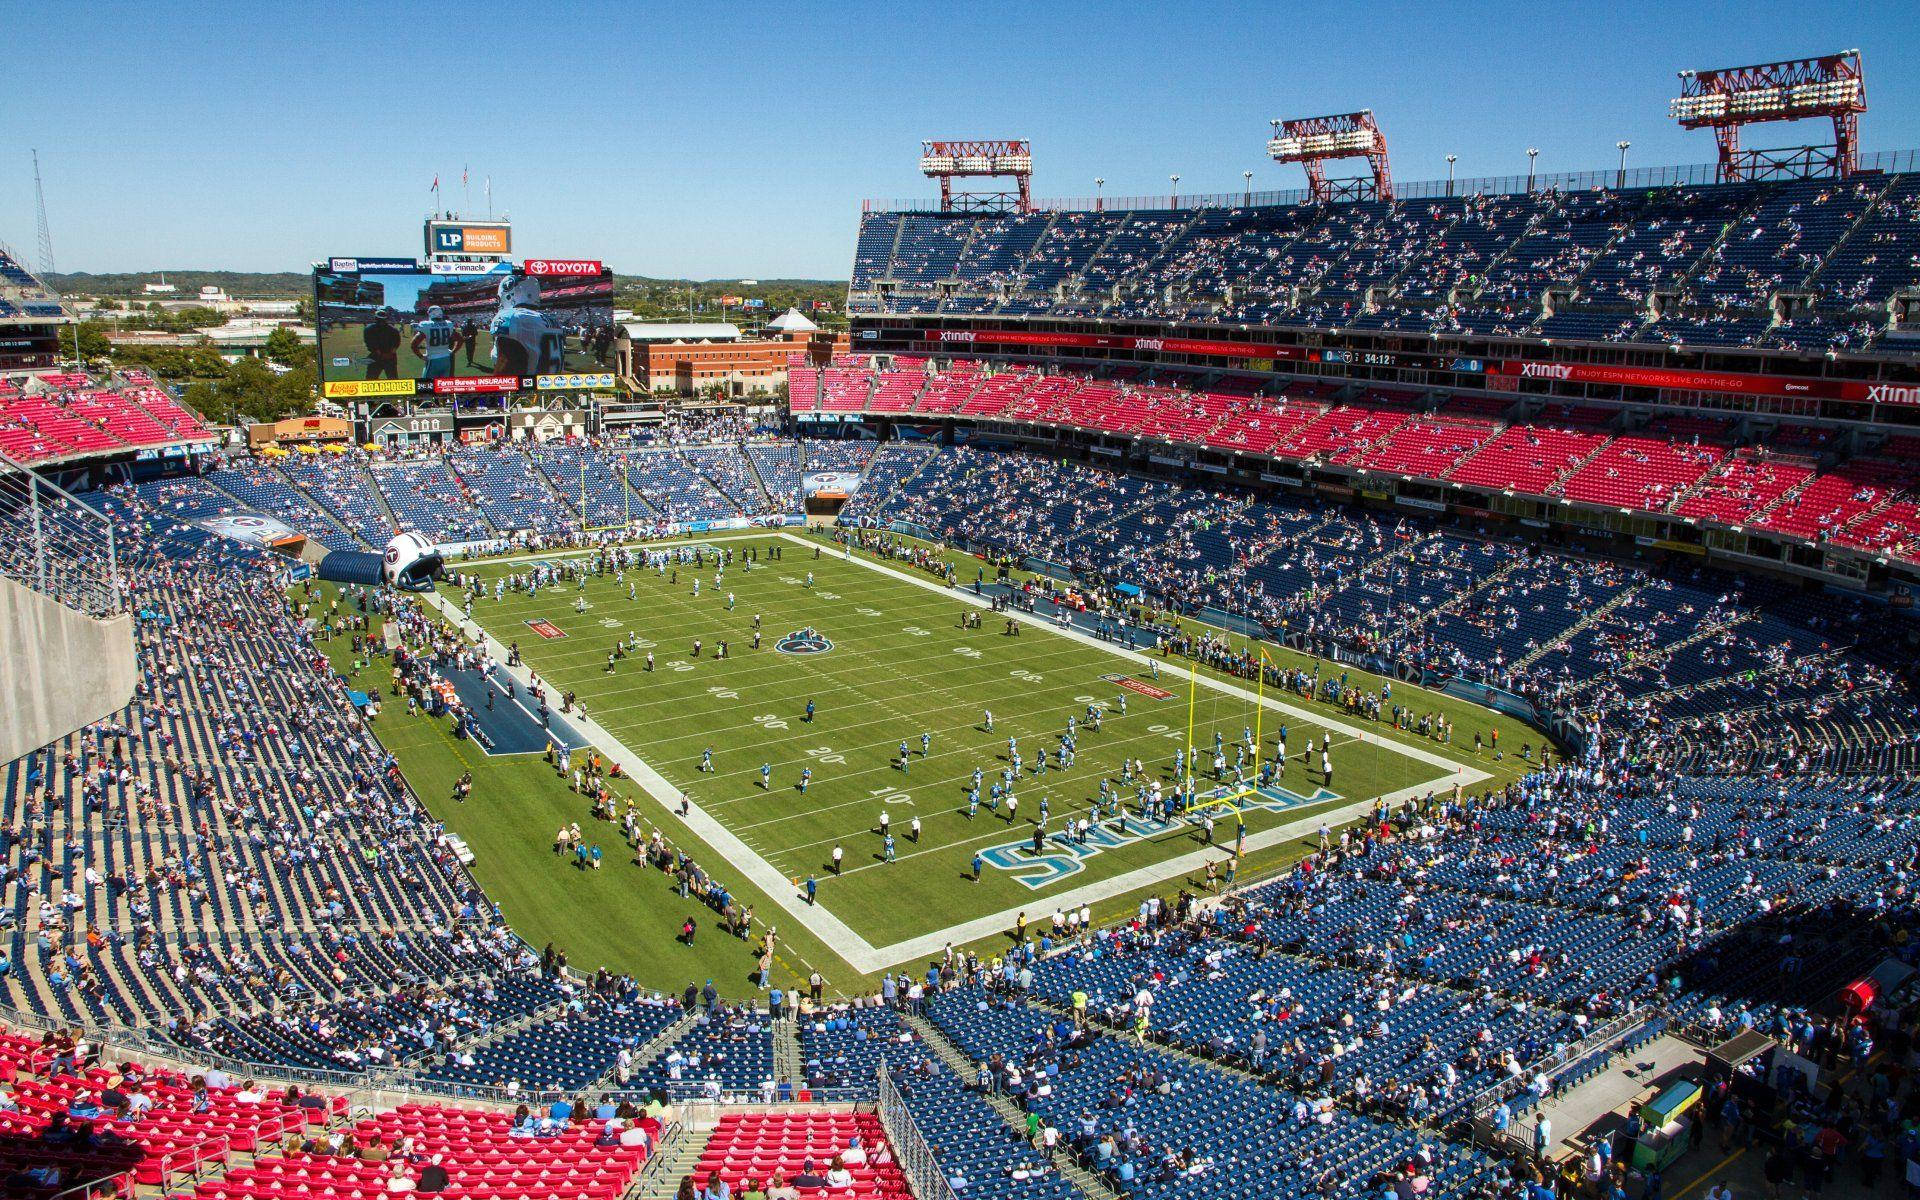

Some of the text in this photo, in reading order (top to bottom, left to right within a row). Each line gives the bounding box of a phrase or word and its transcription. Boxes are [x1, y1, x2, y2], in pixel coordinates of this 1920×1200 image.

[440, 234, 462, 246] LP
[455, 263, 486, 272] Pinnacle
[550, 263, 597, 272] TOYOTA
[940, 331, 977, 343] xfinity
[1135, 338, 1164, 350] xfinity
[1326, 351, 1333, 361] 0
[1364, 353, 1389, 364] 34:12
[1470, 360, 1477, 371] 0
[1521, 362, 1573, 380] xfinity
[1625, 373, 1671, 383] NETWORKS
[1694, 377, 1743, 387] ON-THE-GO
[362, 382, 412, 392] ROADHOUSE
[665, 660, 695, 672] 50
[706, 686, 738, 698] 40
[753, 714, 788, 729] 30
[1147, 724, 1185, 738] 10
[805, 746, 845, 763] 20
[869, 786, 912, 804] 10
